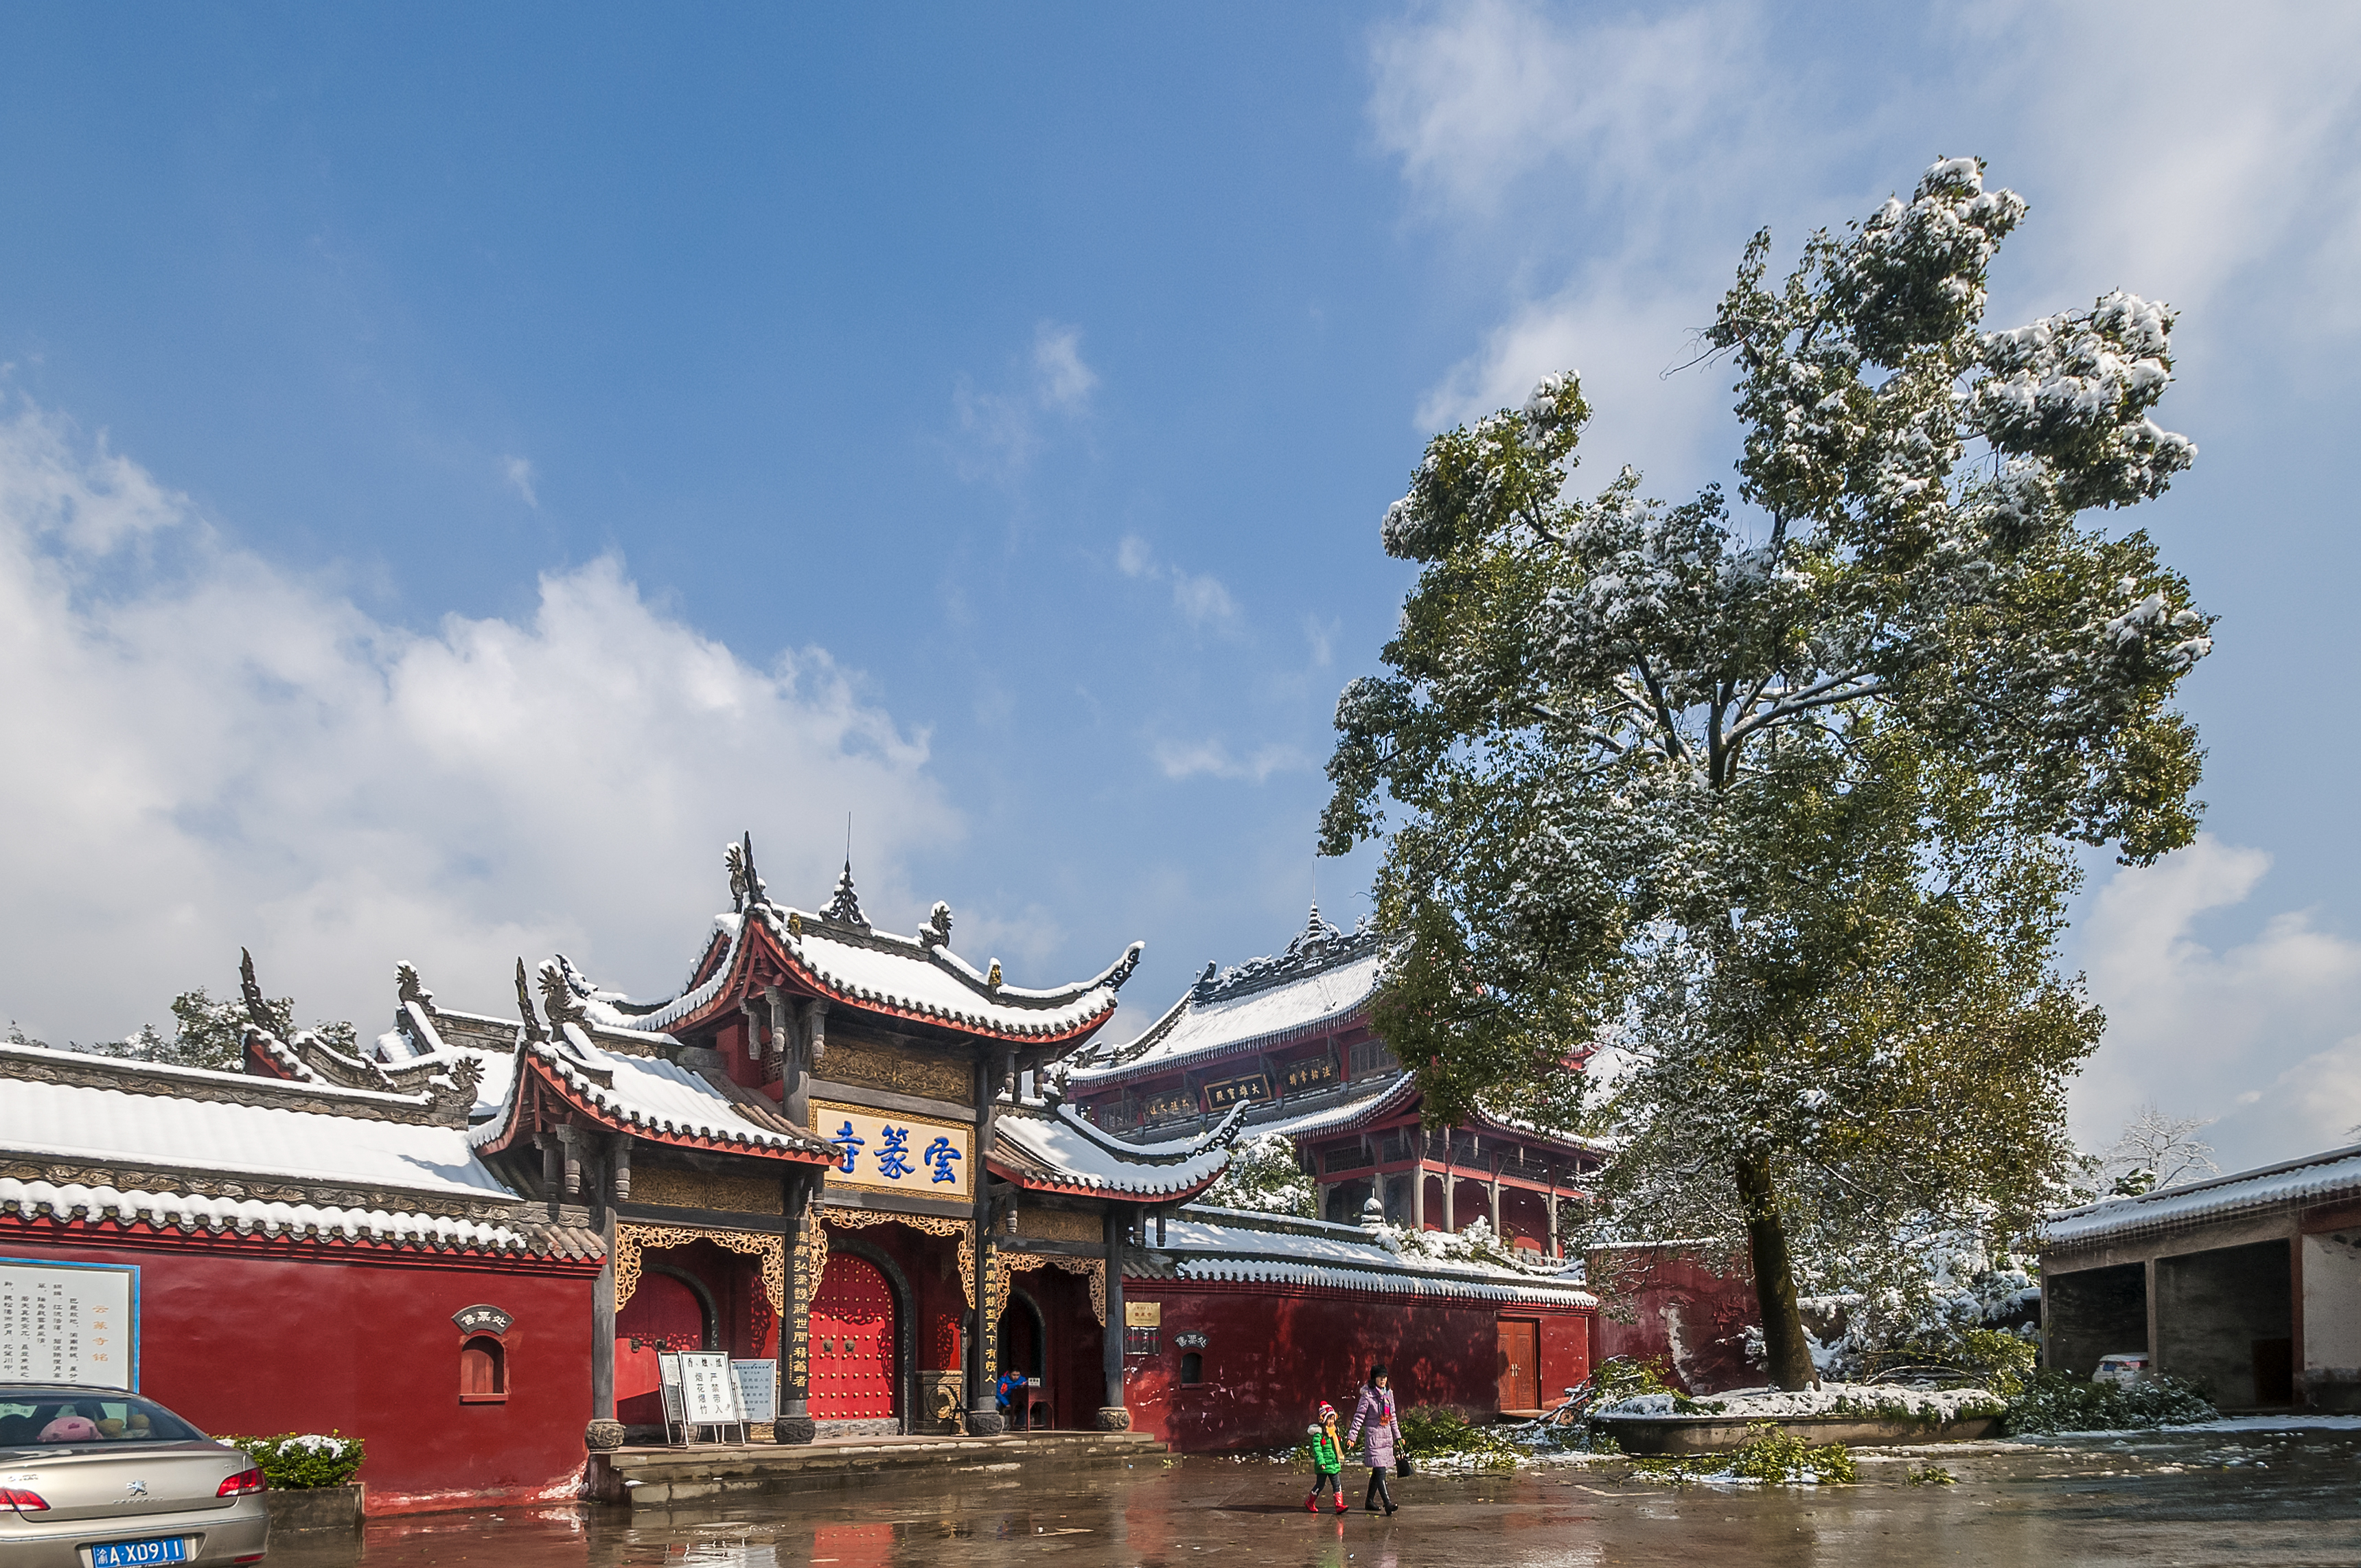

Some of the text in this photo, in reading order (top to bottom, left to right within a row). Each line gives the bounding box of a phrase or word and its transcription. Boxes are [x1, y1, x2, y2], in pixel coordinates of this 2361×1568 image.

[461, 1311, 507, 1328] 售票处
[695, 1372, 708, 1414] 烟花爆竹
[710, 1372, 723, 1414] 严禁带入
